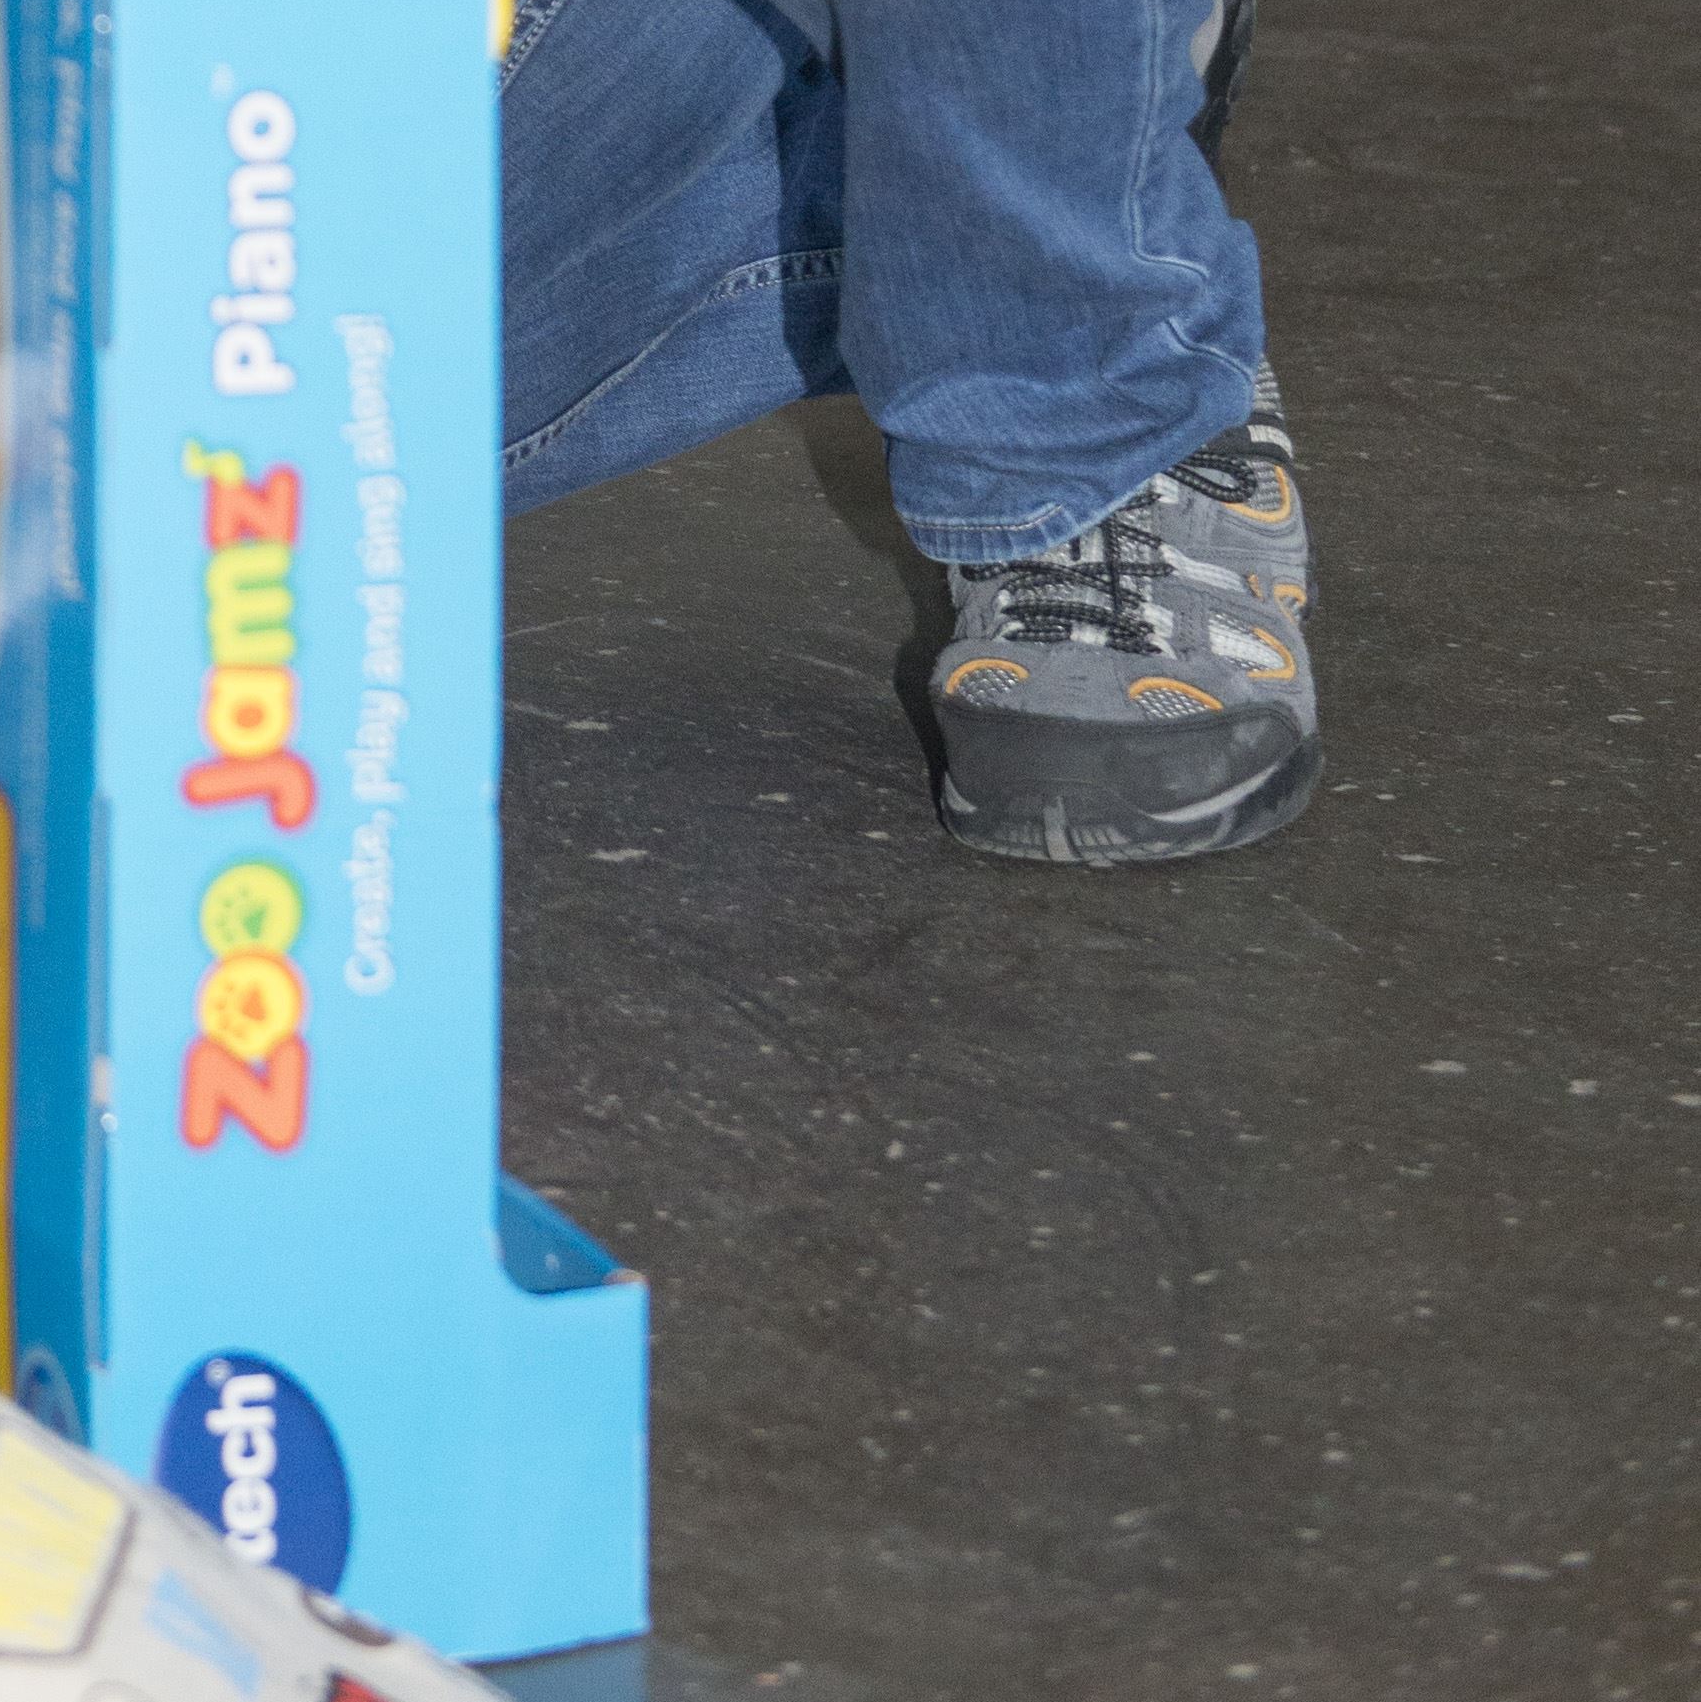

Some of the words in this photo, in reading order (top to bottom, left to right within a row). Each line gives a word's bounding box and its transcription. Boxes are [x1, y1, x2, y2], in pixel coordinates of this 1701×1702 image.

[211, 87, 297, 395] Piano
[181, 459, 317, 831] Jamz
[346, 691, 408, 803] play
[357, 586, 406, 685] and
[181, 864, 308, 1152] Zoo
[205, 1373, 277, 1563] ech
